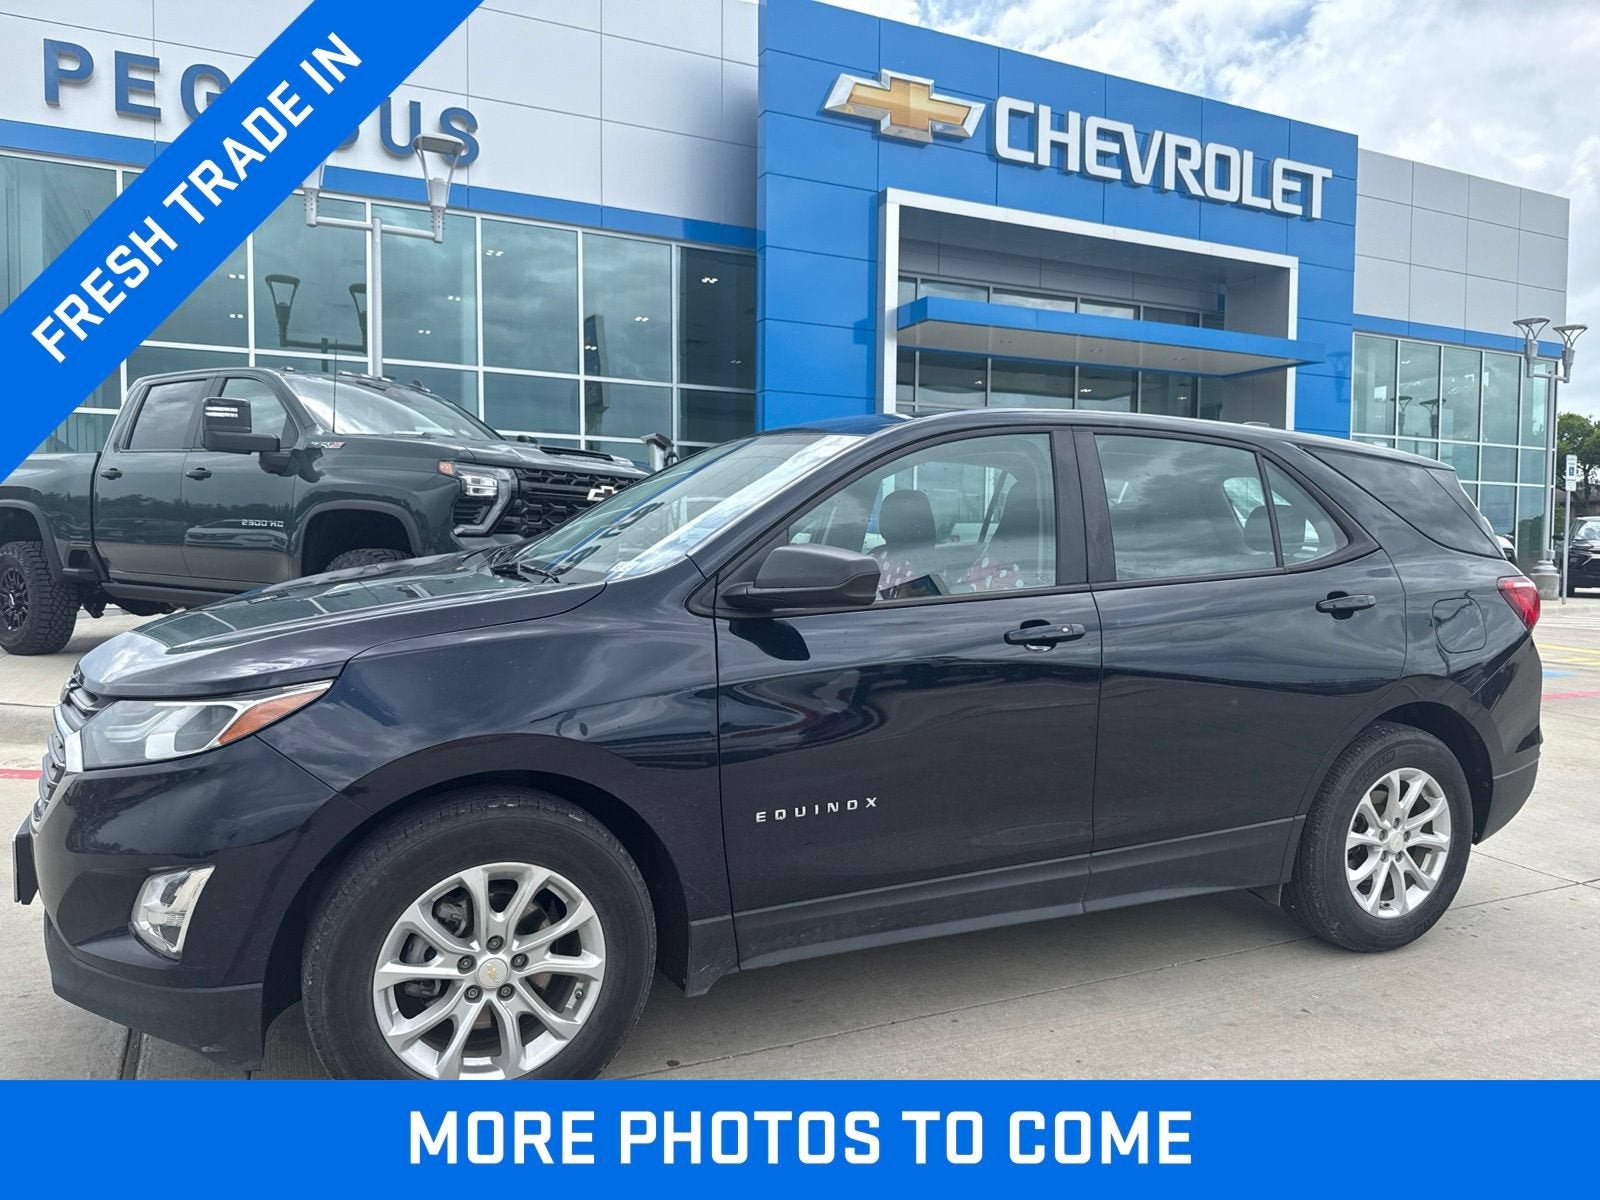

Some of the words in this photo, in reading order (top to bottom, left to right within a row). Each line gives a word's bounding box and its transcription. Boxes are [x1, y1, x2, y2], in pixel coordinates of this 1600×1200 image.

[43, 38, 480, 167] PEGUS
[995, 95, 1333, 220] CHEVROLET
[755, 797, 877, 823] EQUINOX
